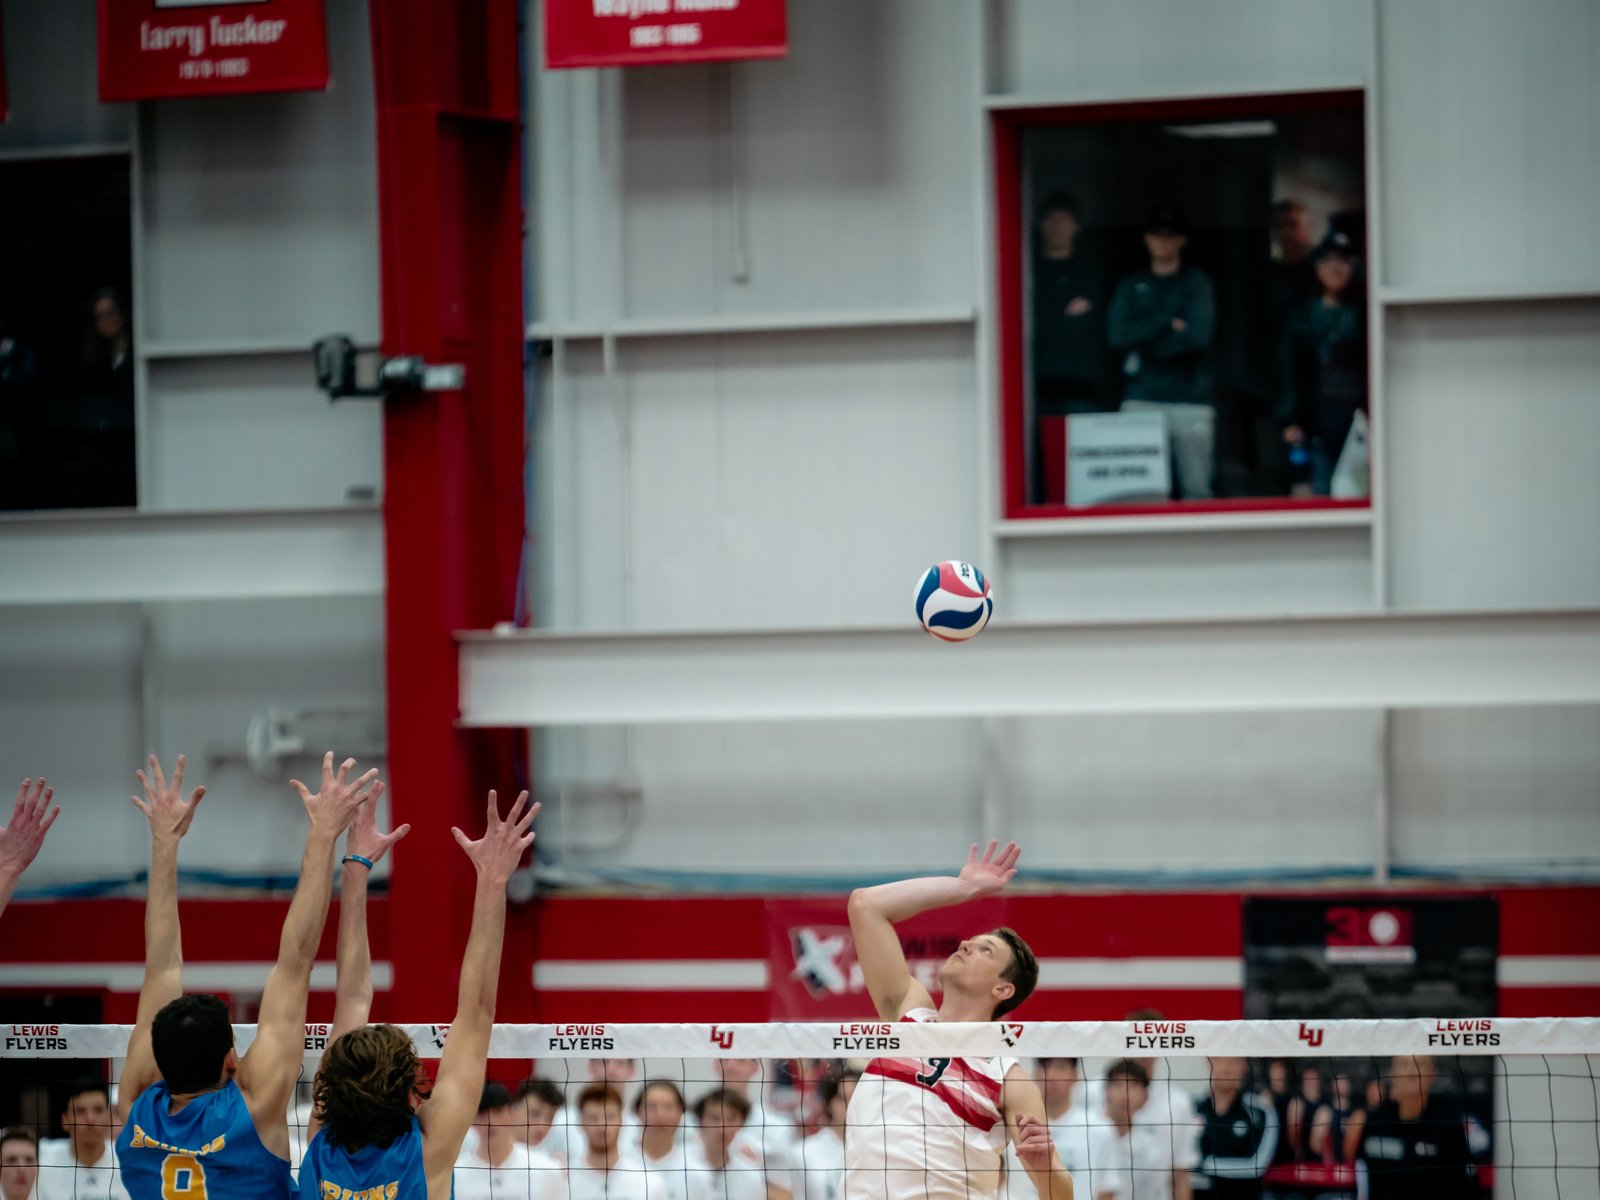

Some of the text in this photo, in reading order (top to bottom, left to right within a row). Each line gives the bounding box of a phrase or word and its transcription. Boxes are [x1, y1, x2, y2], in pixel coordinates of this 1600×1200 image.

[140, 14, 287, 56] Larry Tucker
[13, 1026, 59, 1036] LEWIS
[556, 1025, 605, 1036] LEWIS
[840, 1024, 891, 1035] LEWIS
[1134, 1023, 1186, 1034] LEWIS
[1437, 1020, 1491, 1031] LEWIS
[6, 1038, 67, 1050] FLYERS
[549, 1038, 614, 1050] FLYERS
[833, 1037, 900, 1050] FLYERS
[1126, 1036, 1195, 1049] FLYERS
[1428, 1033, 1500, 1046] FLYERS
